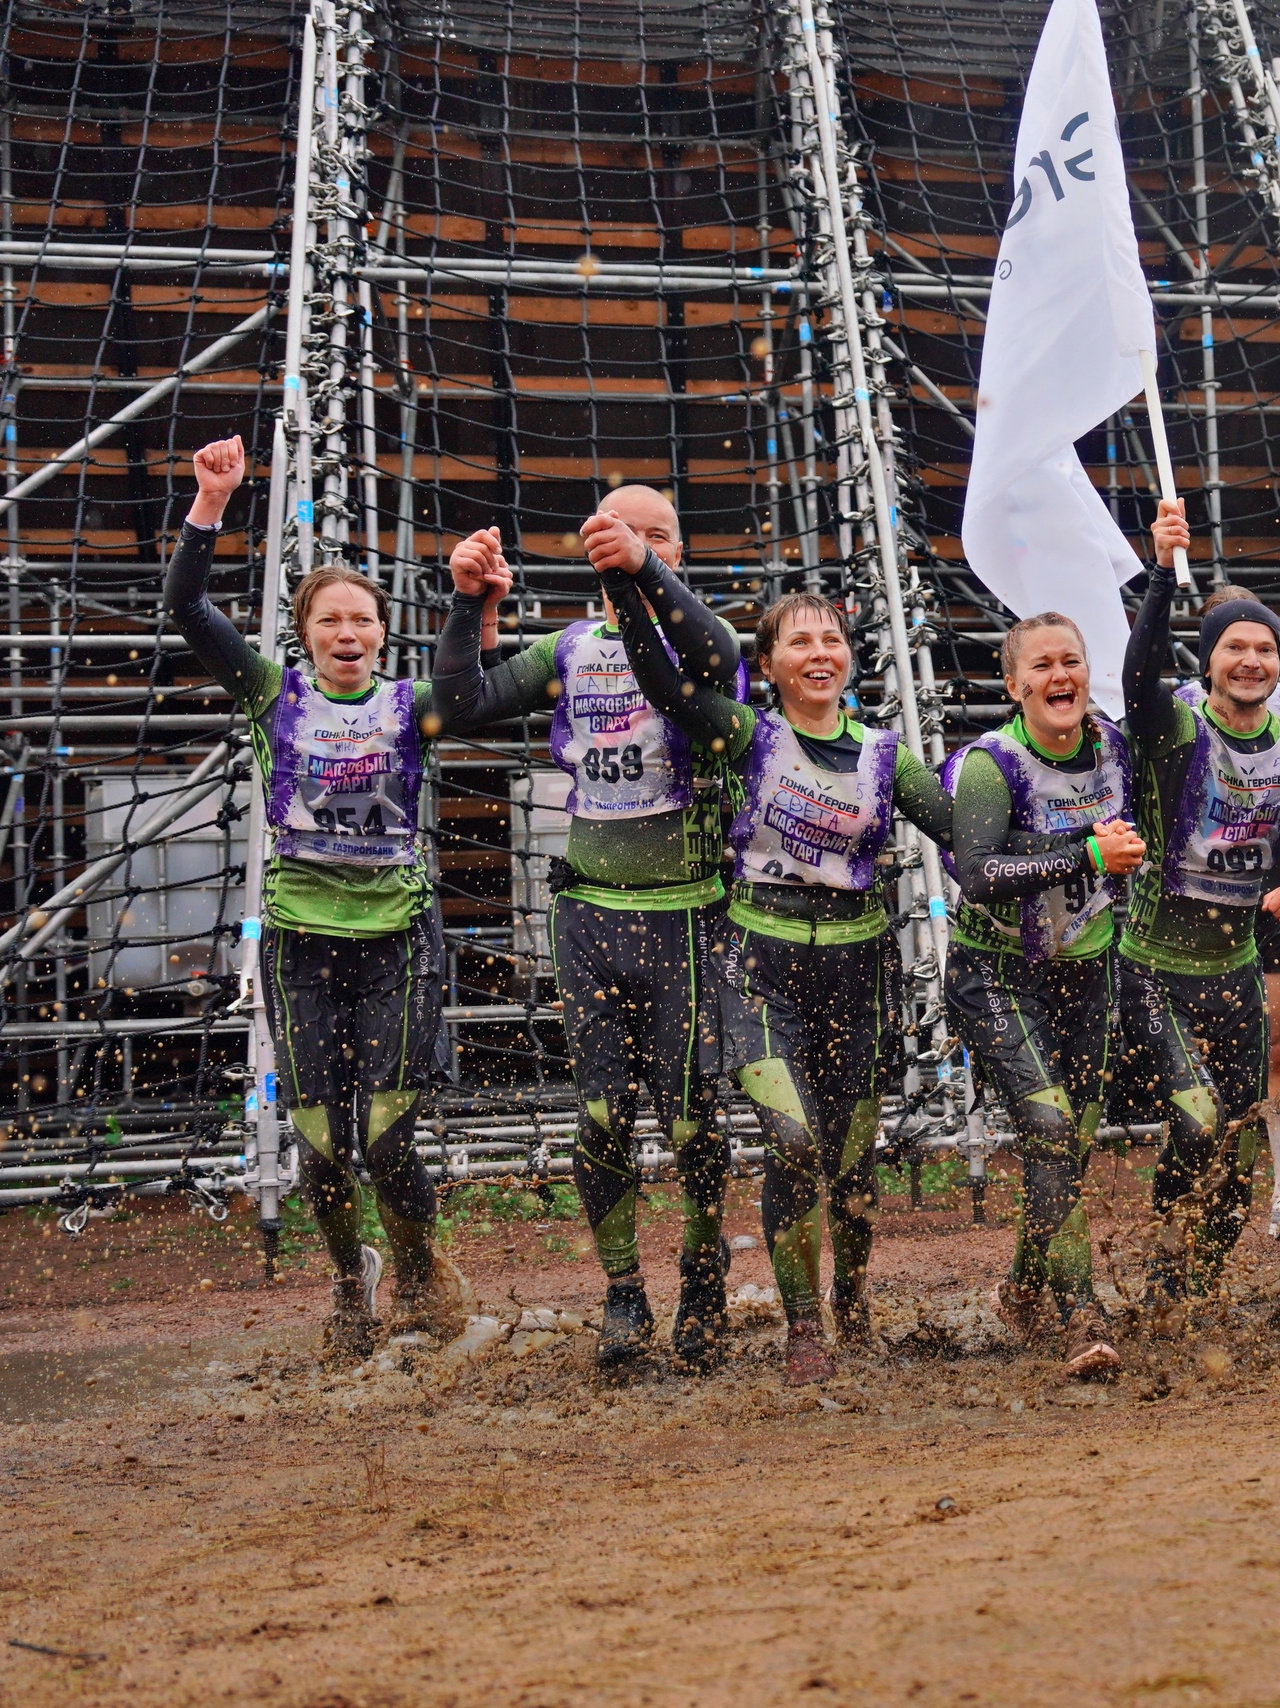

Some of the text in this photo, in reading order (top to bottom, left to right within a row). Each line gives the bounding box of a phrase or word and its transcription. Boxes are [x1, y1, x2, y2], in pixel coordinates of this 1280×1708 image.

[606, 663, 633, 673] ГЕРО
[575, 692, 645, 716] МАССОВЫЙ
[591, 715, 629, 732] СТАРТ
[581, 743, 645, 784] 959
[327, 775, 369, 794] СТАРТ
[779, 775, 861, 815] ГОНКА ГЕРОЕВ
[856, 782, 868, 800] 5
[1079, 786, 1113, 805] ГЕРОЕВ
[313, 803, 387, 836] 954
[773, 789, 841, 831] СВЕТА
[767, 806, 848, 852] МАССОВЫЙ
[332, 842, 394, 856] ГАЗПРОМБАНК
[783, 836, 821, 865] СТАРТ
[984, 858, 1074, 877] Greenway
